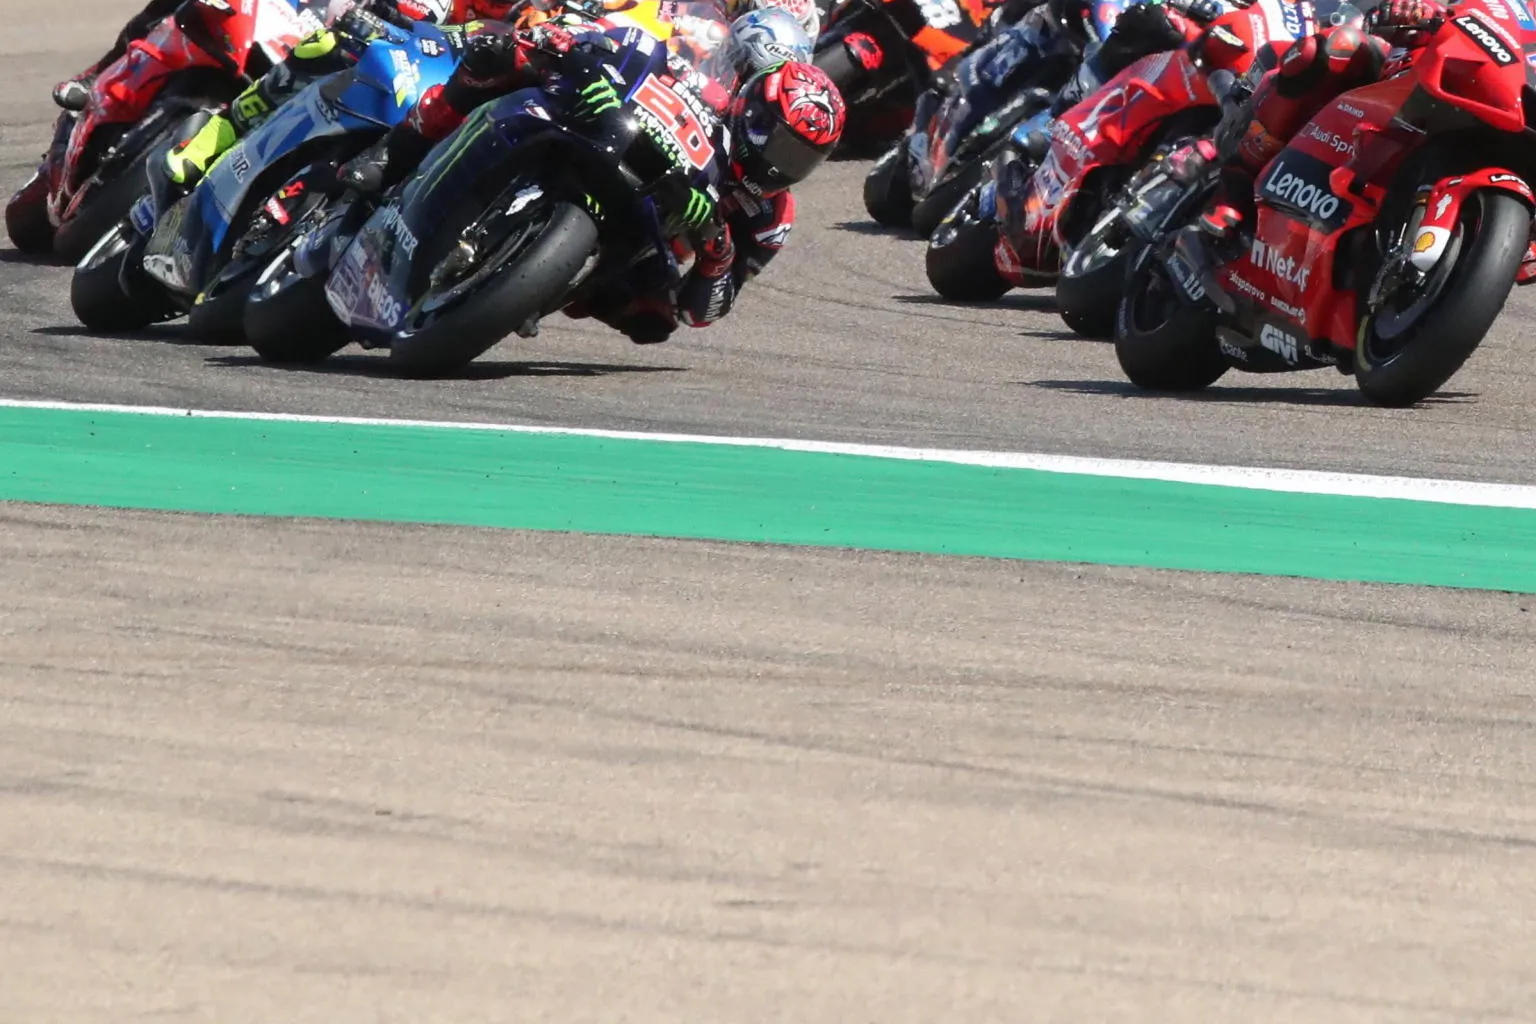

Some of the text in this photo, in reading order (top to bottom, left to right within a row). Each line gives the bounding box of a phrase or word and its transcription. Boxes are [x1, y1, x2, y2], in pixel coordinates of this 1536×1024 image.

[1455, 17, 1512, 63] Lenovo
[631, 72, 716, 171] 20
[633, 105, 692, 176] MONSTER
[1265, 161, 1339, 219] Lenovo
[1260, 324, 1298, 363] GIVI
